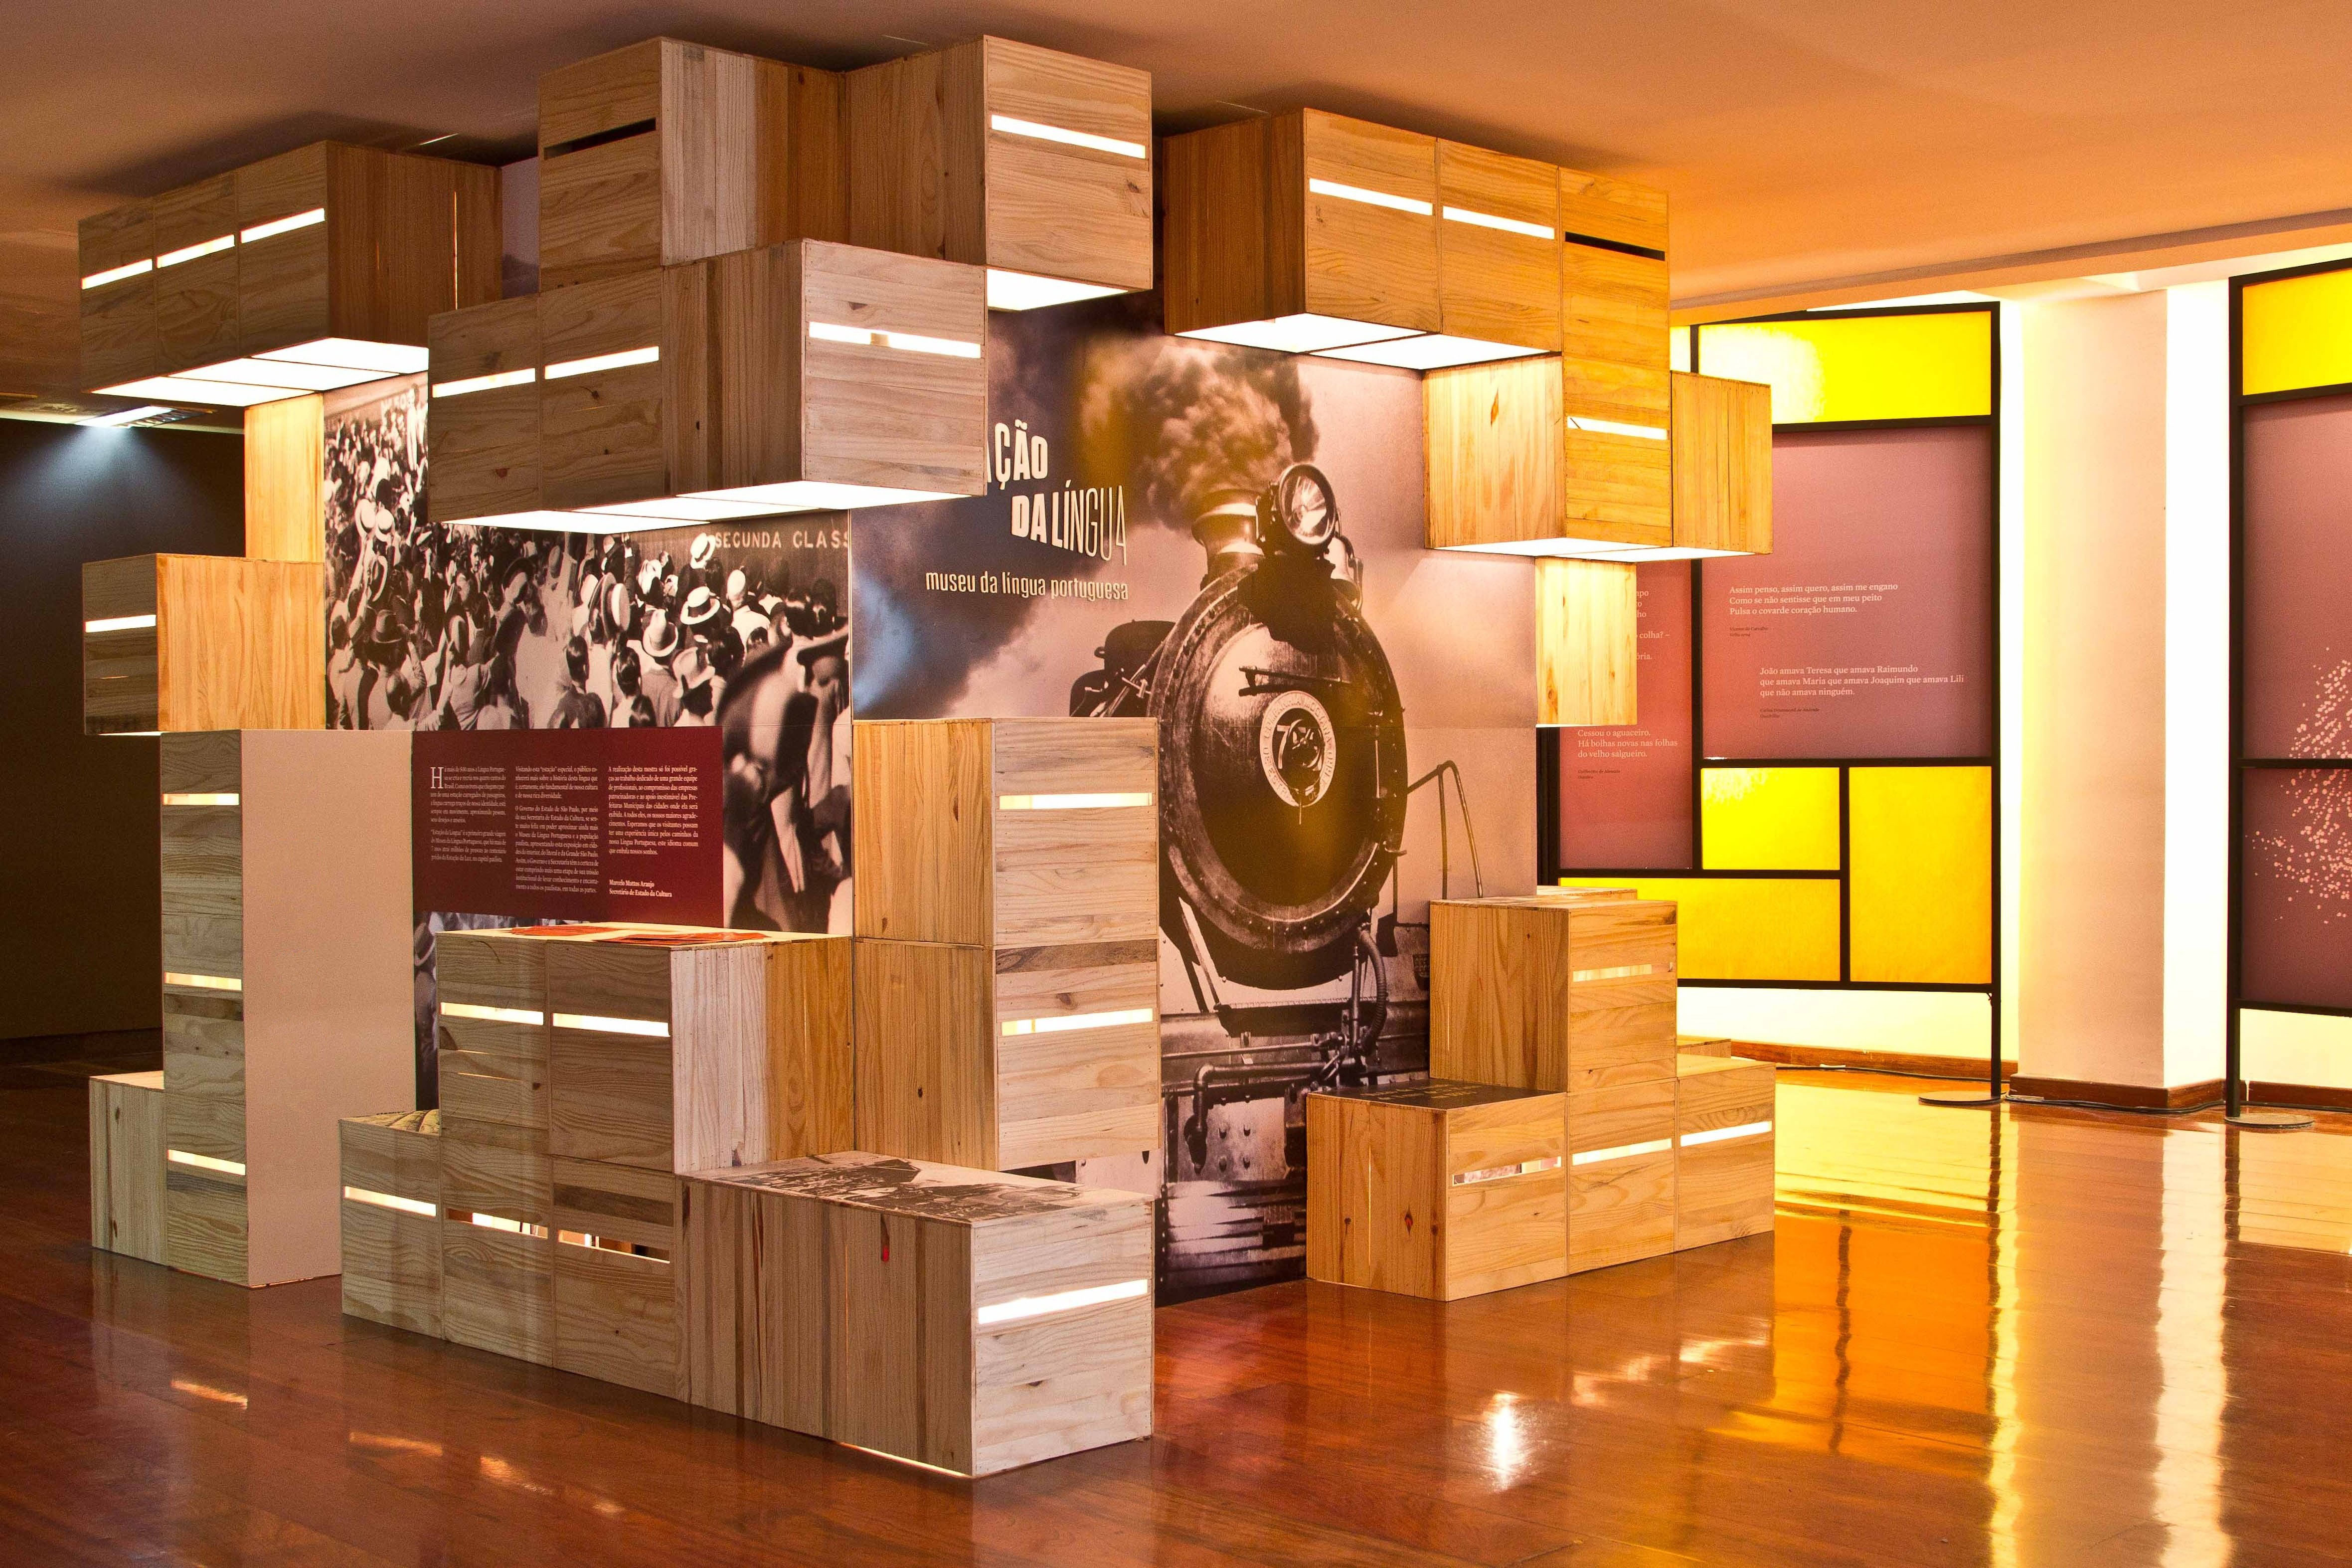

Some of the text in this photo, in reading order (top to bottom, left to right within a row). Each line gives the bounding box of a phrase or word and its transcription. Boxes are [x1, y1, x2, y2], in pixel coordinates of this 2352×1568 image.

[1011, 480, 1127, 566] DA LÍNGUA
[926, 571, 1129, 602] museu da língua portuguesa
[1791, 606, 1821, 615] coração
[1877, 665, 1918, 673] Raimundo
[1870, 676, 1905, 686] Joaquim
[1819, 688, 1855, 697] ninguém.
[1613, 729, 1651, 738] aguaceiro.
[1591, 739, 1615, 747] bolhas
[1611, 750, 1647, 759] salgueiro.
[641, 880, 655, 888] Araujo
